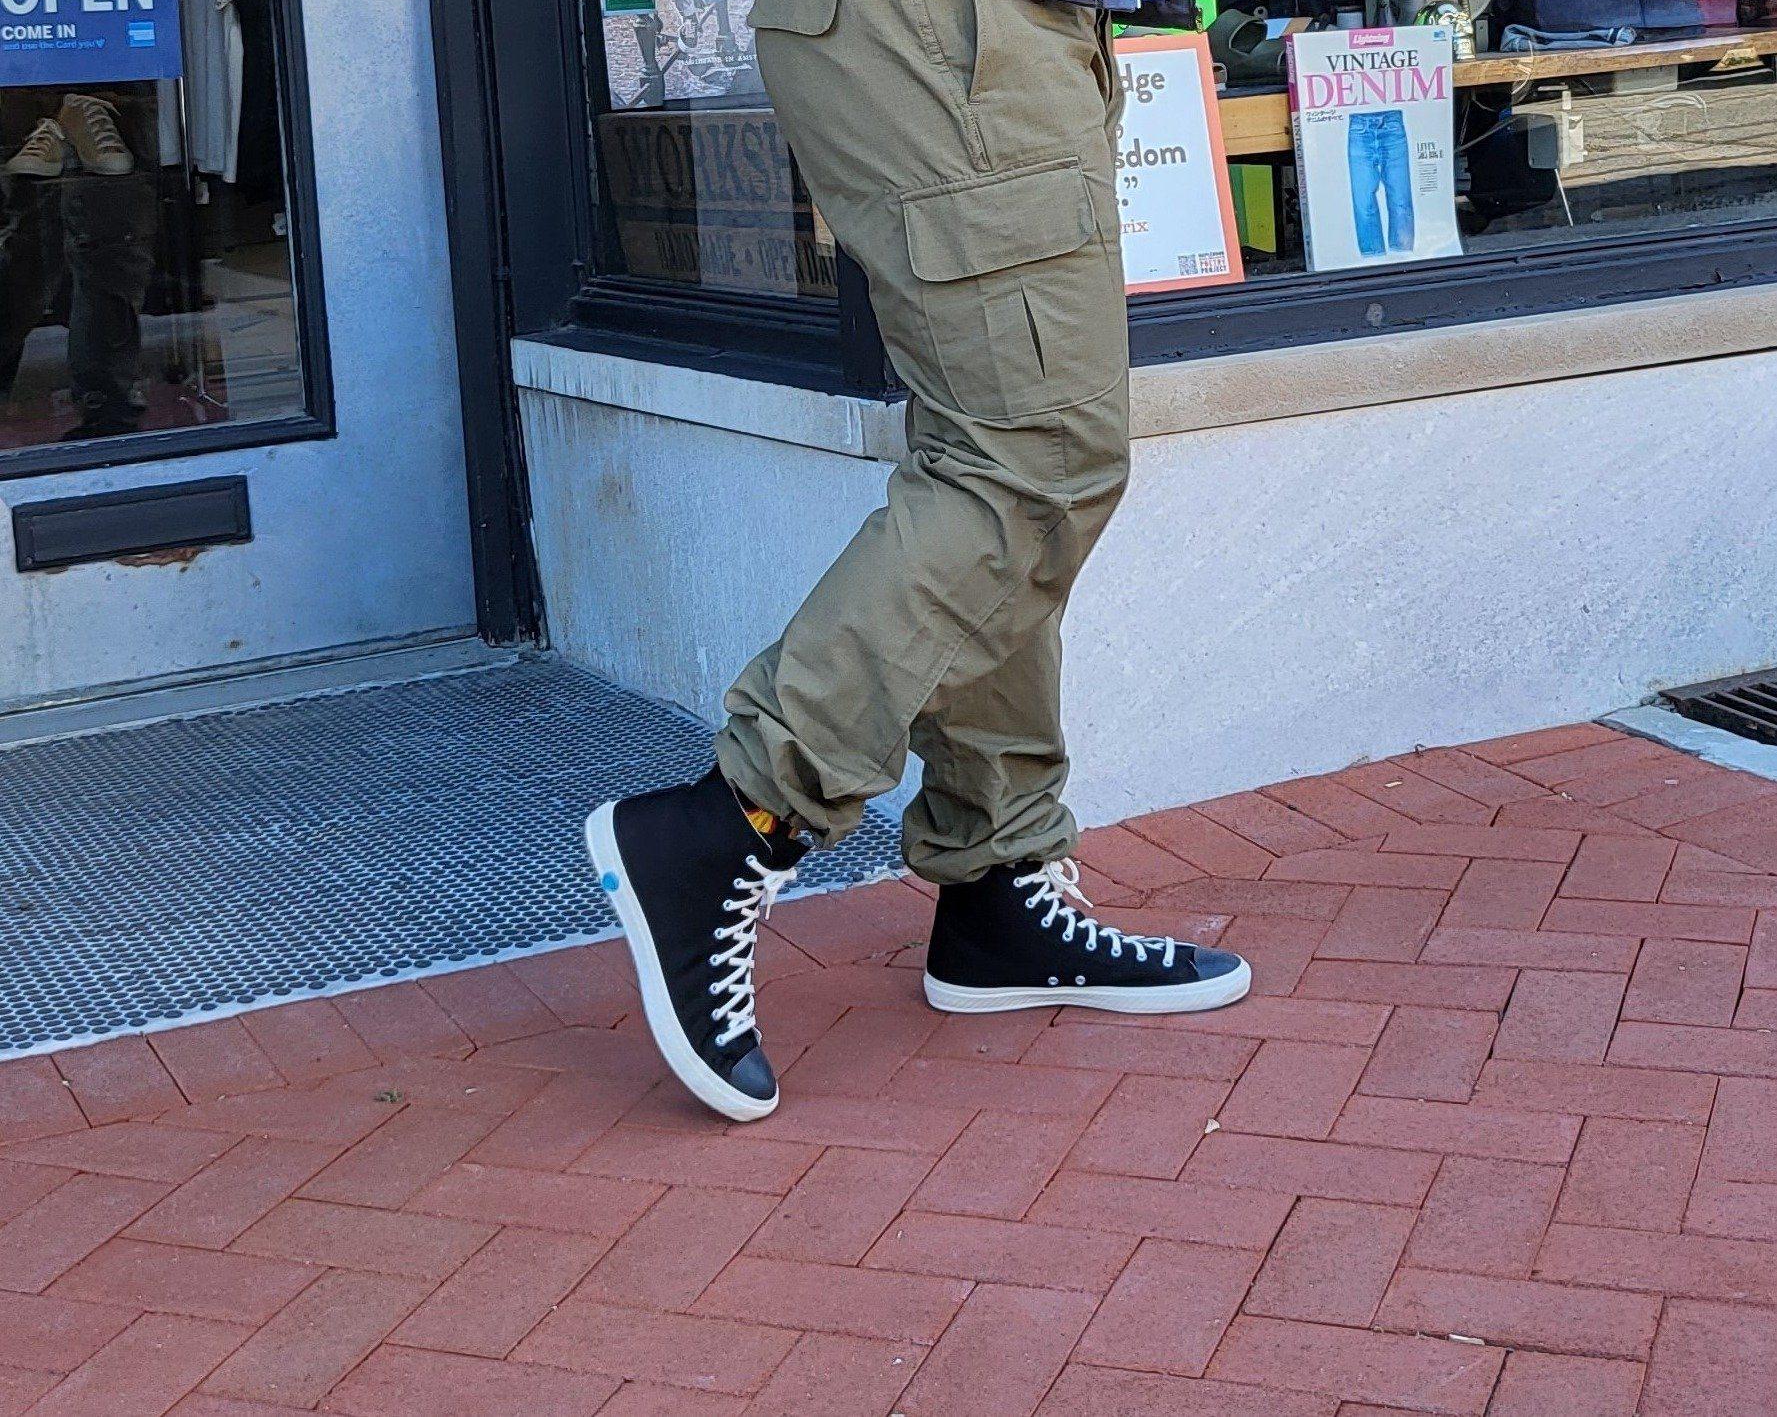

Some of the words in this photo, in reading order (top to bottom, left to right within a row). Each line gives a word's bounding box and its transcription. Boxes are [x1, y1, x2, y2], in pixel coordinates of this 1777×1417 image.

[1, 25, 53, 40] COME
[57, 24, 76, 38] IN
[1326, 50, 1420, 73] VINTAGE
[1119, 63, 1165, 103] dge
[1302, 66, 1448, 109] DENIM
[1116, 138, 1187, 170] sdom
[1121, 219, 1149, 234] rix
